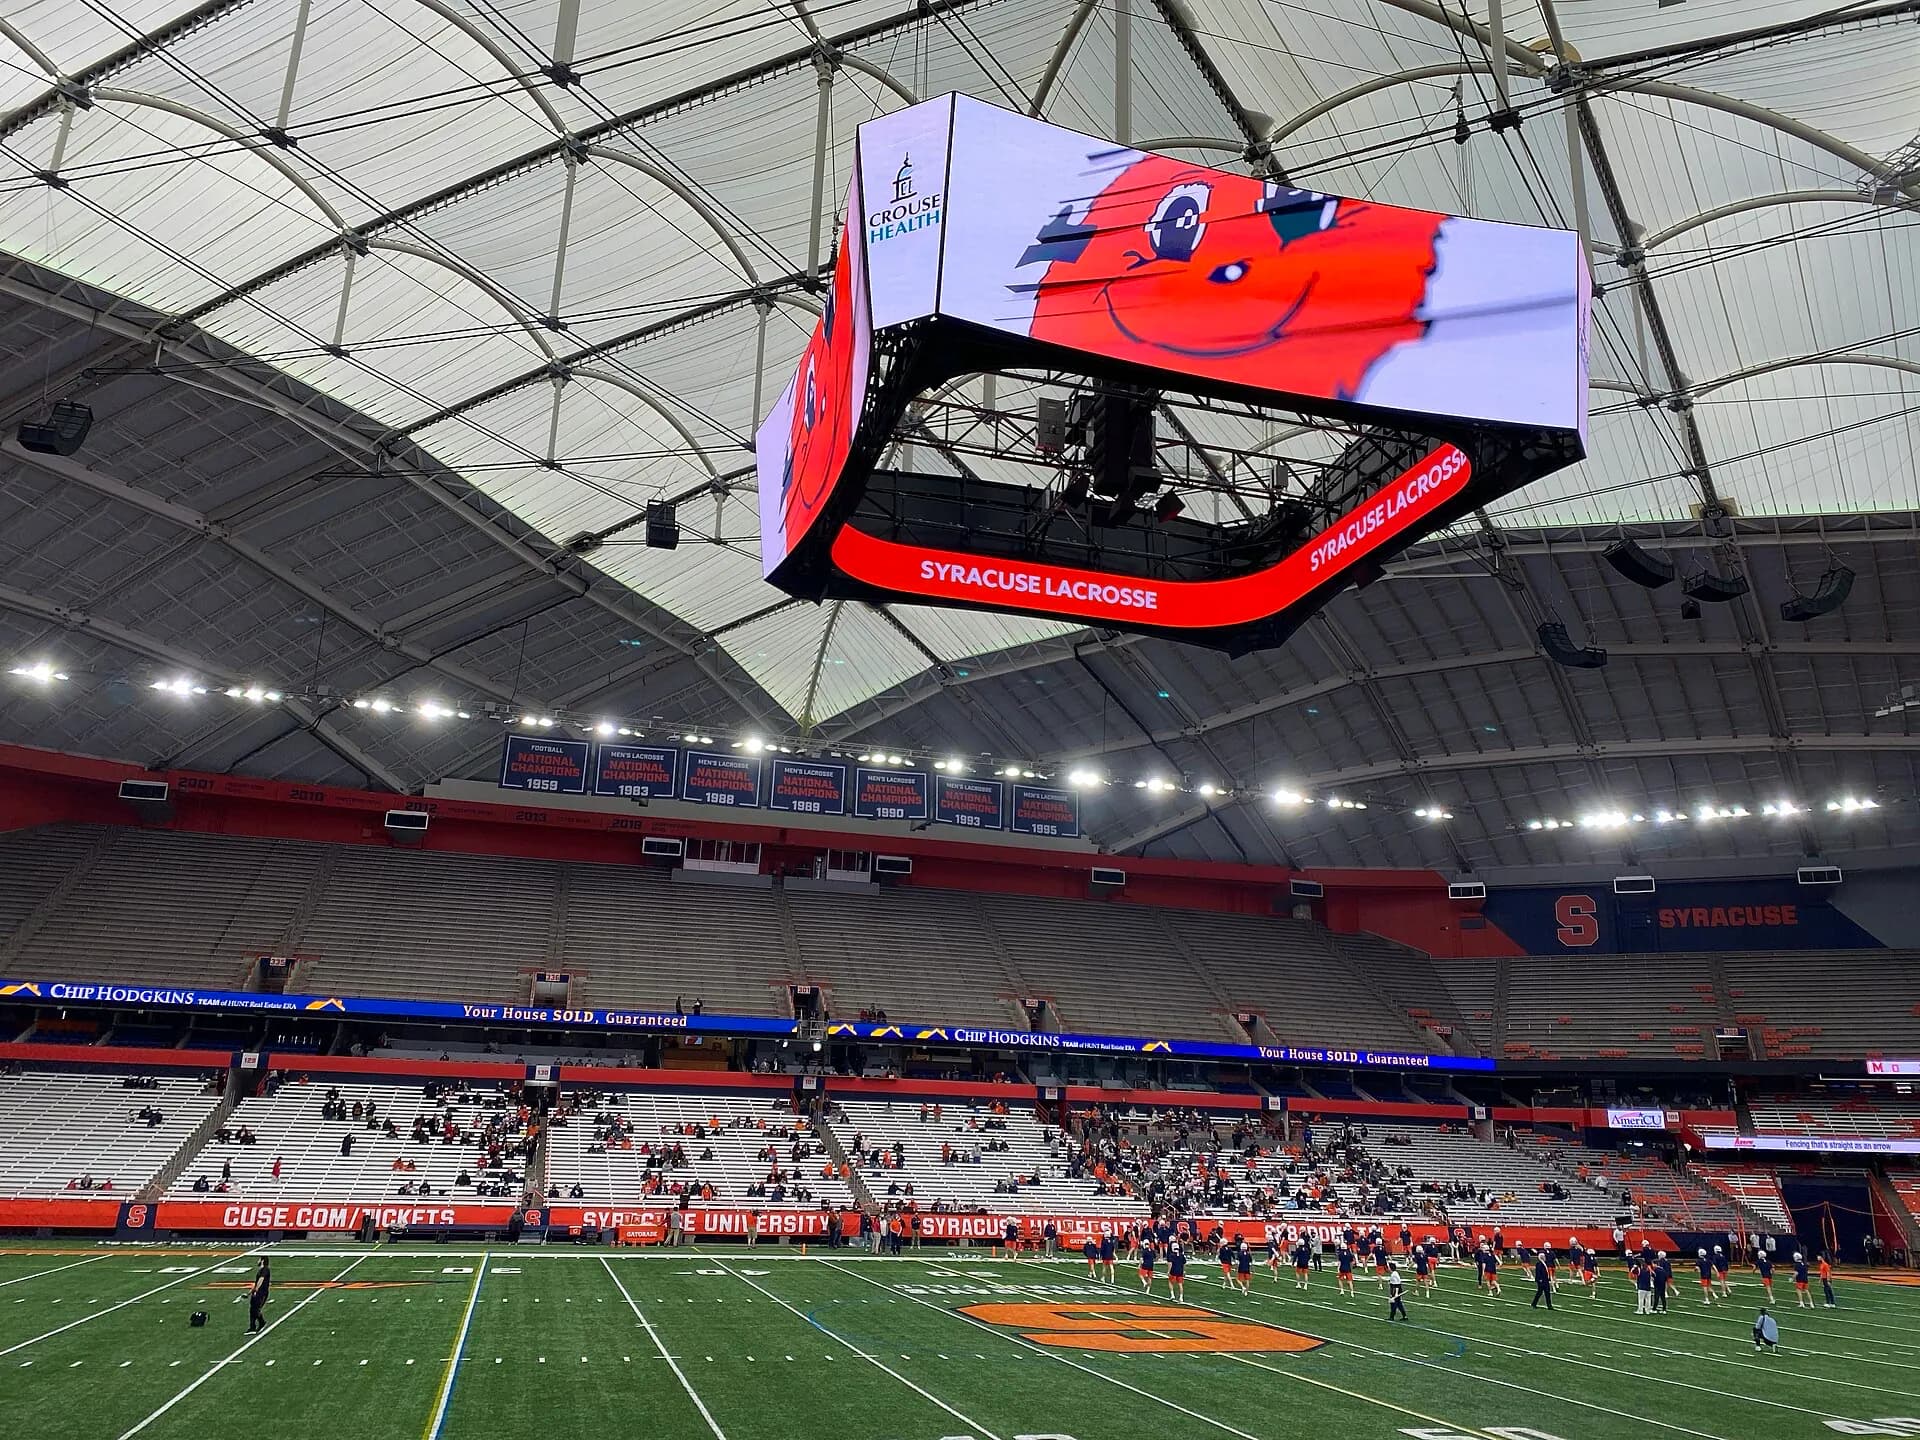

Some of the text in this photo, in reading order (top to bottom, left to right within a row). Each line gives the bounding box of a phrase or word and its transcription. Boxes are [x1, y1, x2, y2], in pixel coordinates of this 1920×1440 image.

[870, 194, 940, 227] CROUSE
[870, 210, 940, 243] HEALTH
[1310, 504, 1385, 572] SYRACUSE
[921, 560, 1158, 609] SYRACUSE LACROSSE
[531, 744, 563, 754] FOOTBALL
[611, 751, 665, 761] MEN'S LACROSSE
[518, 752, 576, 768] NATIONAL
[609, 759, 665, 773] NATIONAL
[698, 758, 750, 770] MEN'S LACROSSE
[511, 762, 580, 778] CHAMPIONS
[602, 769, 670, 783] CHAMPIONS
[696, 766, 751, 781] NATIONAL
[784, 766, 834, 778] MEN'S LACROSSE
[526, 778, 558, 791] 1959
[690, 776, 755, 792] CHAMPIONS
[783, 775, 834, 789] NATIONAL
[867, 774, 916, 785] MEN'S LACROSSE
[618, 784, 649, 797] 1983
[777, 785, 840, 800] CHAMPIONS
[866, 783, 918, 796] NATIONAL
[946, 782, 992, 793] MEN'S LACROSSE
[861, 791, 923, 805] CHAMPIONS
[945, 789, 993, 804] NATIONAL
[1023, 791, 1068, 802] MEN'S LACROSSE
[792, 800, 820, 813] 1989
[876, 807, 904, 818] 1990
[940, 799, 998, 814] CHAMPIONS
[1022, 799, 1069, 813] NATIONAL
[515, 810, 547, 822] 2013
[955, 813, 981, 826] 1993
[1017, 808, 1073, 823] CHAMPIONS
[1031, 823, 1057, 836] 1995
[1555, 894, 1600, 947] S
[1657, 904, 1799, 929] SYRACUSE
[50, 983, 94, 1001] CHIP
[96, 986, 195, 1005] HODGKINS
[249, 1000, 263, 1008] Real
[264, 1001, 282, 1009] Estate
[463, 1005, 688, 1028] Your House SOLD, Guaranteed
[954, 1028, 986, 1043] CHIP
[988, 1030, 1060, 1047] HODGKINS
[1258, 1046, 1429, 1067] Your House SOLD, Guaranteed
[1872, 1062, 1884, 1073] M
[1611, 1113, 1662, 1125] AmeriCU
[1785, 1140, 1810, 1149] Fencing
[1811, 1140, 1827, 1149] that's
[1829, 1140, 1853, 1151] straight
[127, 1205, 147, 1228] S
[704, 1211, 830, 1234] UNIERSITY
[953, 1302, 1330, 1353] S
